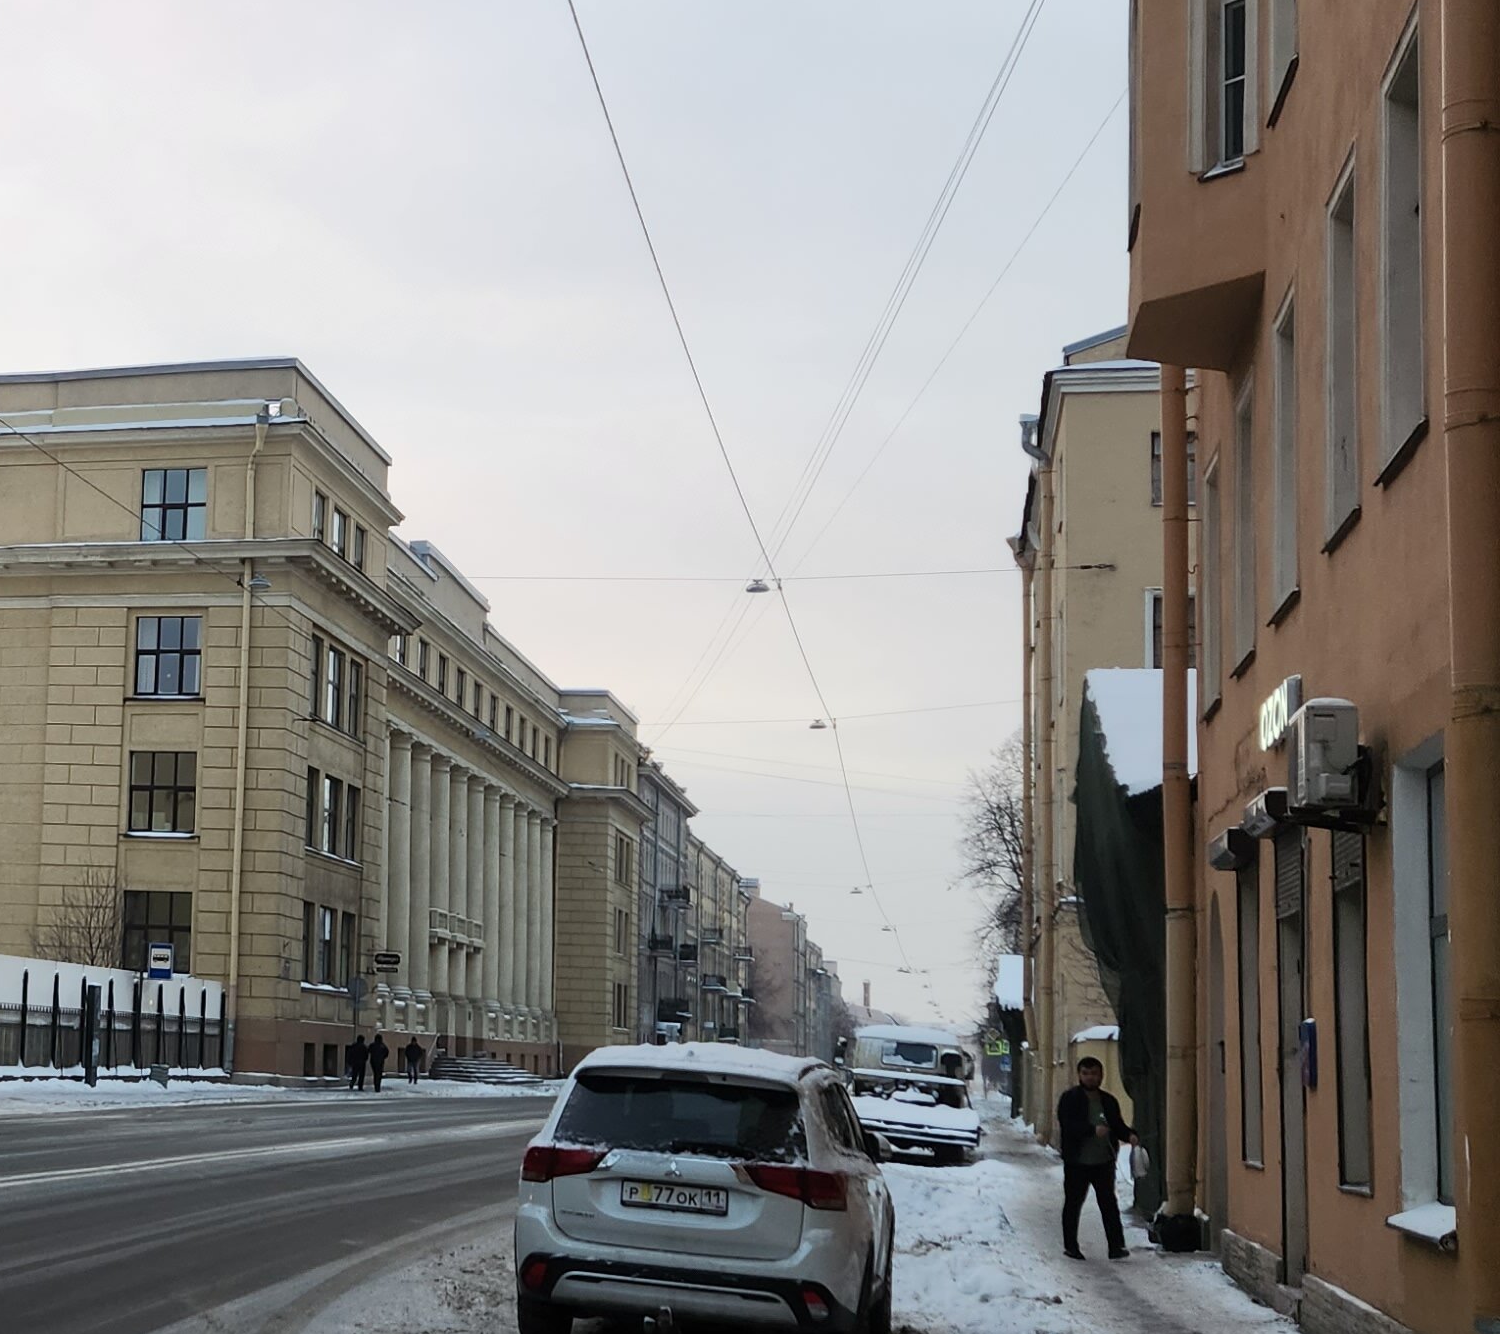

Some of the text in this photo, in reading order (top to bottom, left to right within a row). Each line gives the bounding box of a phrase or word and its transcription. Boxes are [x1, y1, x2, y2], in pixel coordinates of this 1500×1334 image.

[1259, 679, 1288, 752] OZON
[629, 1186, 720, 1206] Р77ОК 11
